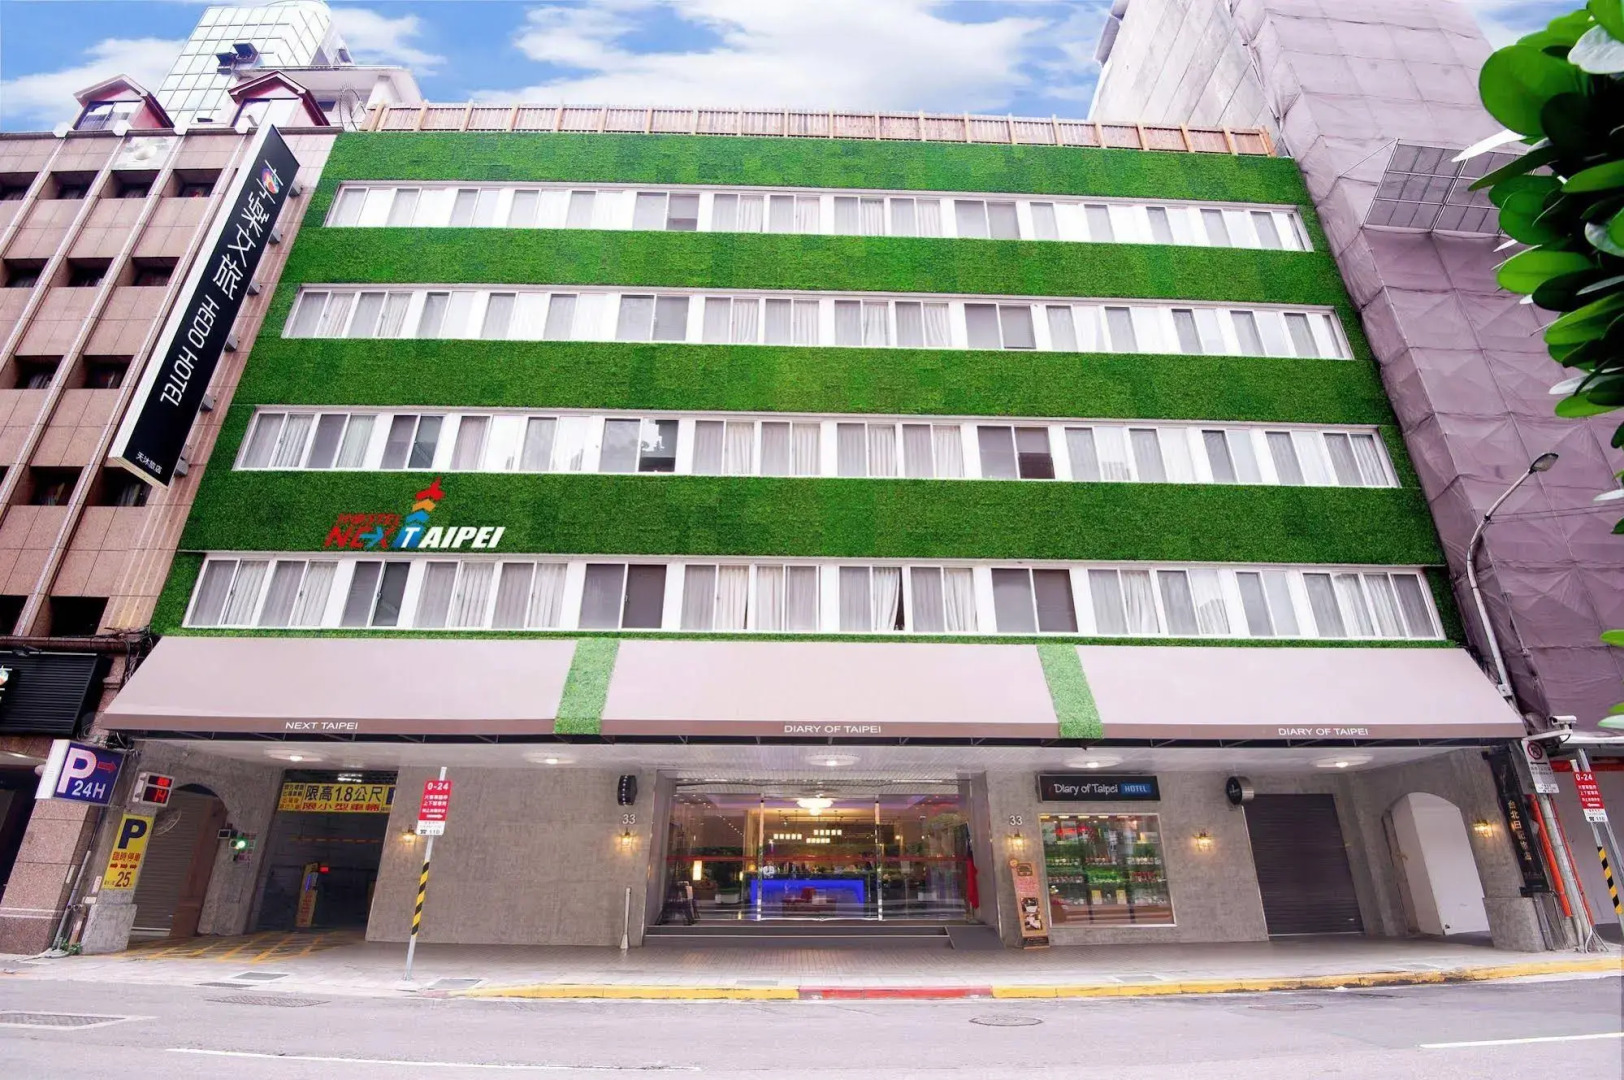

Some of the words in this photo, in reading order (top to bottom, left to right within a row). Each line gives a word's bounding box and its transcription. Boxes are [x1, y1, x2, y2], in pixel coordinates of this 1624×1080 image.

[188, 294, 220, 348] HEDO
[160, 346, 198, 407] HOTEL
[285, 721, 319, 730] NEXT
[320, 721, 359, 730] TAIPEI
[784, 725, 821, 733] DIARY
[824, 725, 841, 733] OF
[843, 725, 881, 733] TAIPEI
[1278, 728, 1313, 736] DIARY
[1315, 728, 1331, 736] OF
[1333, 728, 1369, 736] TAIPEI
[57, 747, 97, 794] P
[1575, 773, 1593, 781] 0-24
[72, 780, 106, 799] 24H
[427, 782, 449, 790] 0-24
[1053, 783, 1079, 796] Diary
[1081, 783, 1091, 794] of
[1092, 783, 1118, 795] Taipei
[304, 785, 383, 802] 限高1.8公尺
[622, 813, 636, 825] 33
[1009, 815, 1023, 826] 33
[118, 818, 148, 850] P
[115, 871, 132, 887] 25
